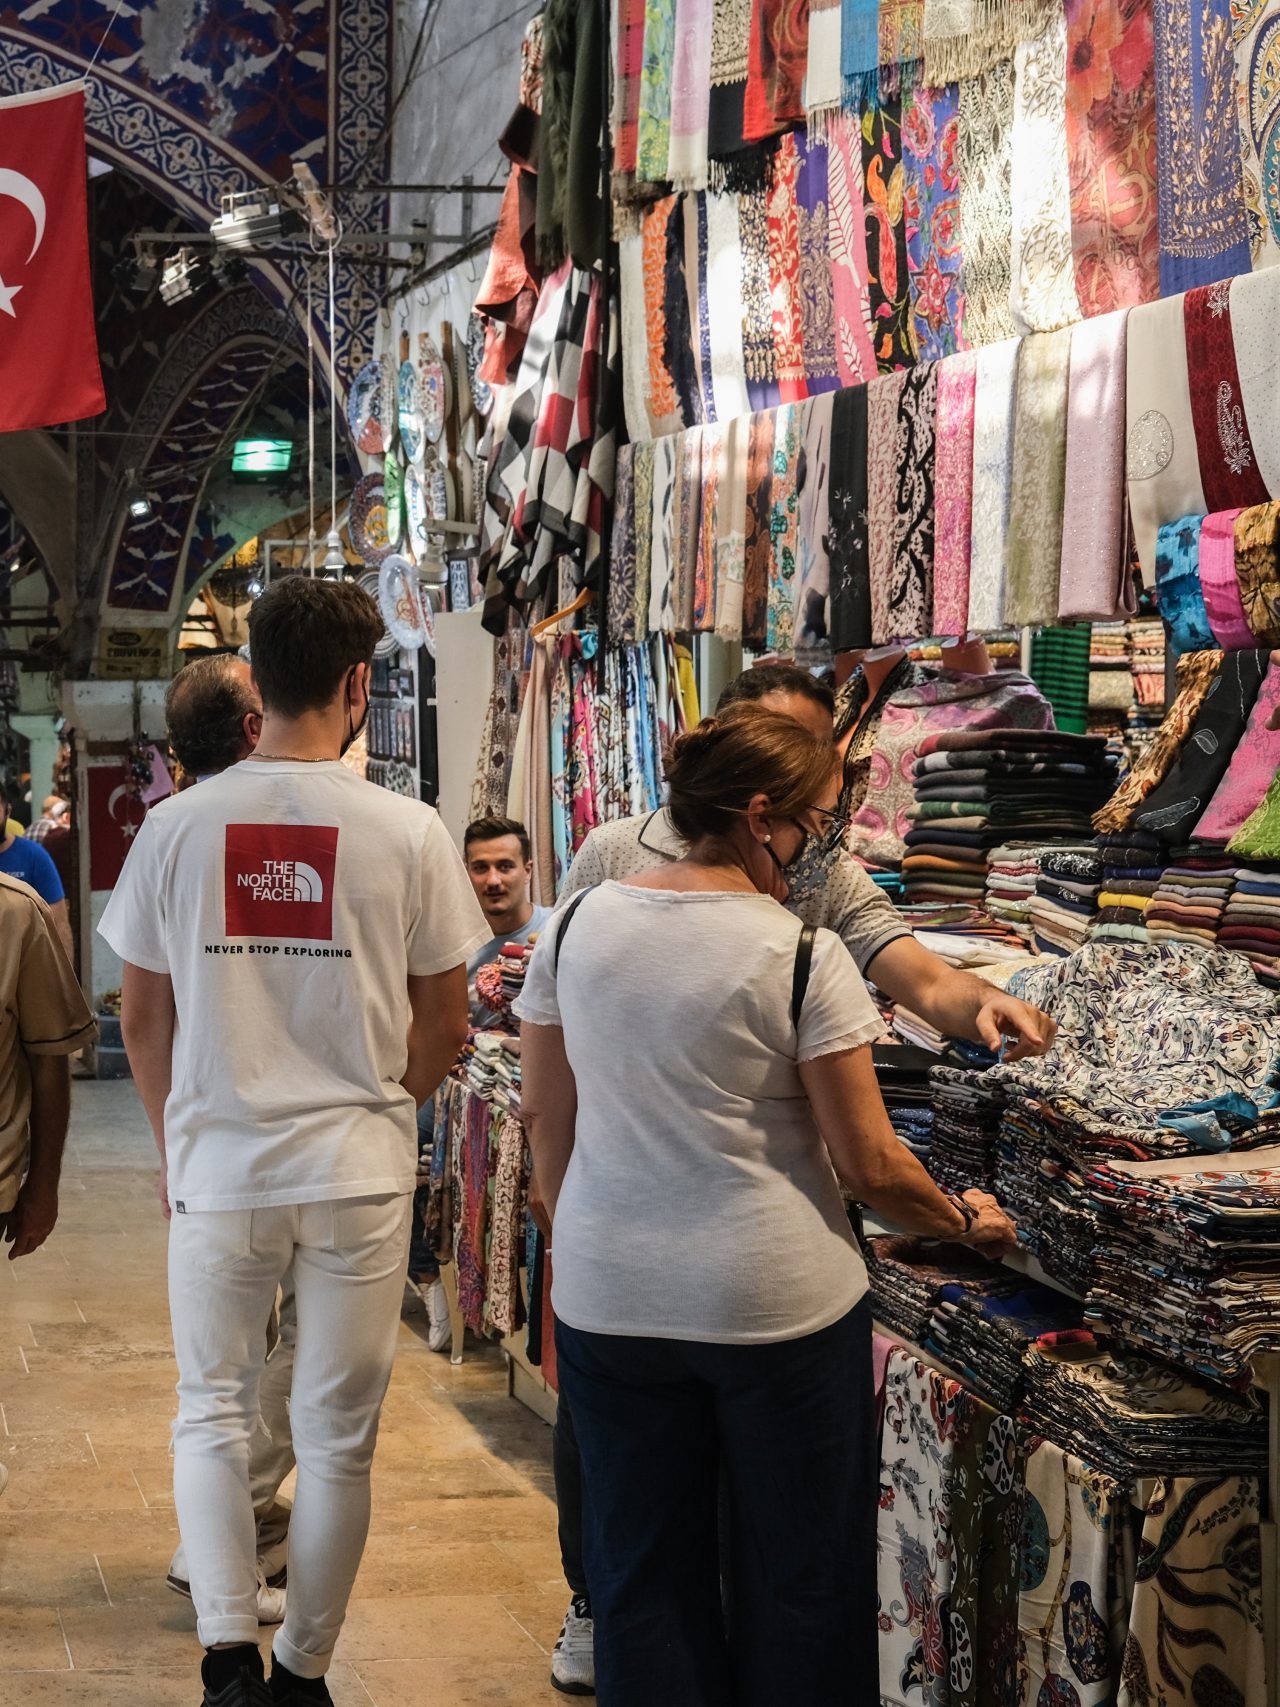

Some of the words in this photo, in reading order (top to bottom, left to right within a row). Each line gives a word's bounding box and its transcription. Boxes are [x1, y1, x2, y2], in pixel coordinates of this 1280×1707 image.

[263, 860, 294, 875] THE
[237, 873, 294, 888] NORTH
[253, 887, 293, 901] FACE
[204, 944, 244, 955] NEVER
[248, 945, 280, 955] STOP
[284, 946, 353, 959] EXPLORING
